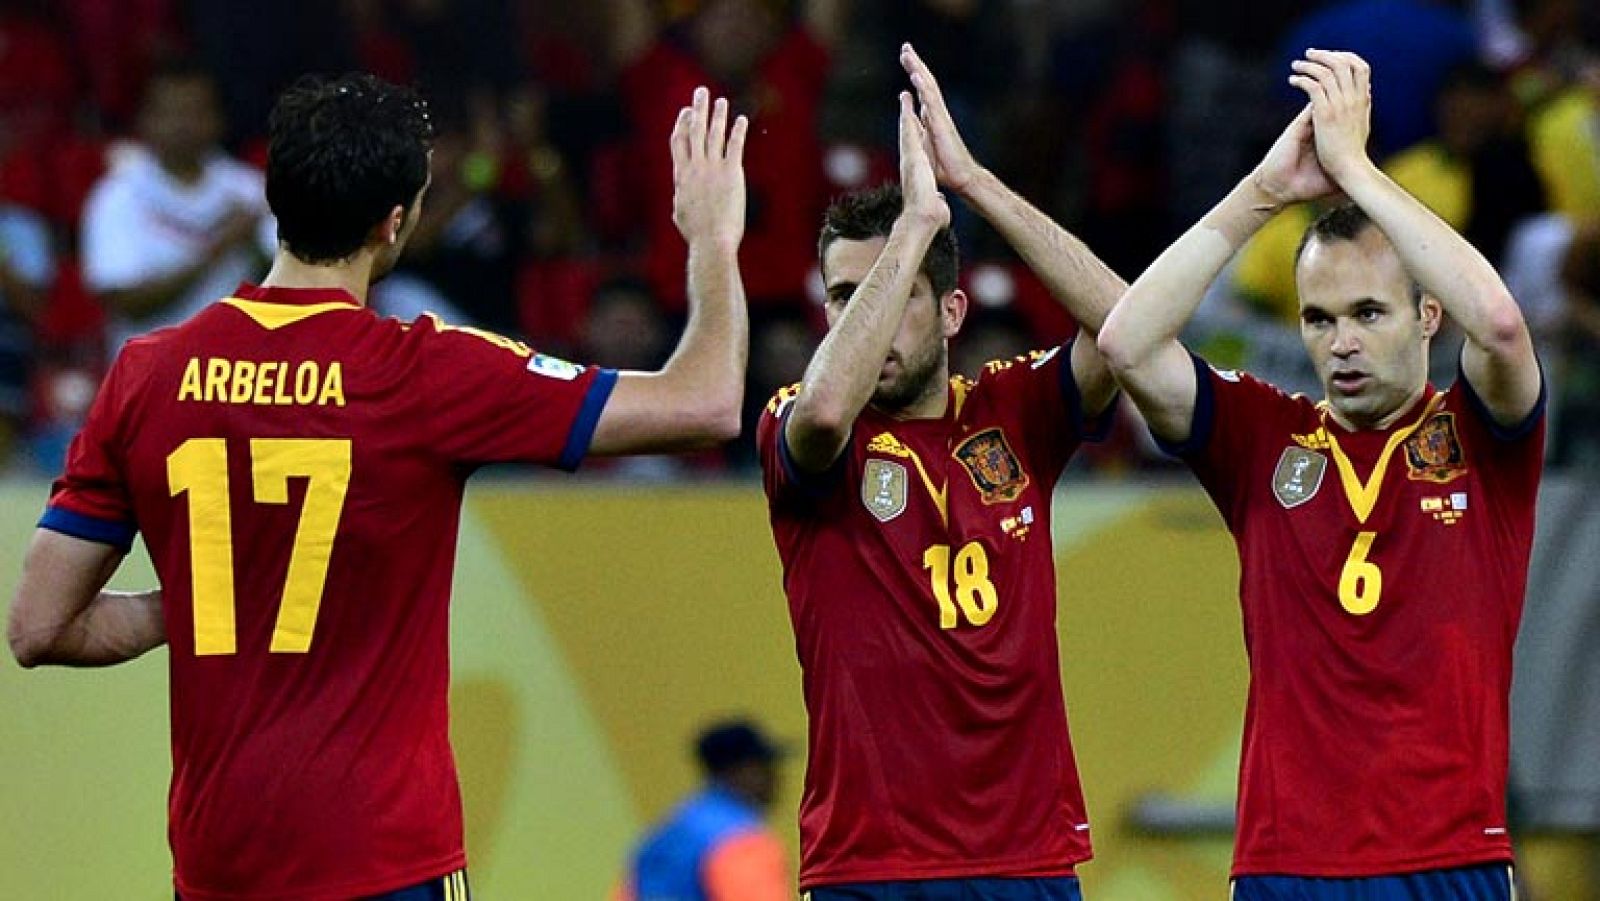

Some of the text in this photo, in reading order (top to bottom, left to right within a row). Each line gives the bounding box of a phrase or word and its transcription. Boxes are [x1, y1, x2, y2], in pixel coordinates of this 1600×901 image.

[178, 357, 346, 406] ARBELOA
[166, 437, 353, 656] 17
[922, 541, 999, 629] 18
[1337, 531, 1382, 616] 6
